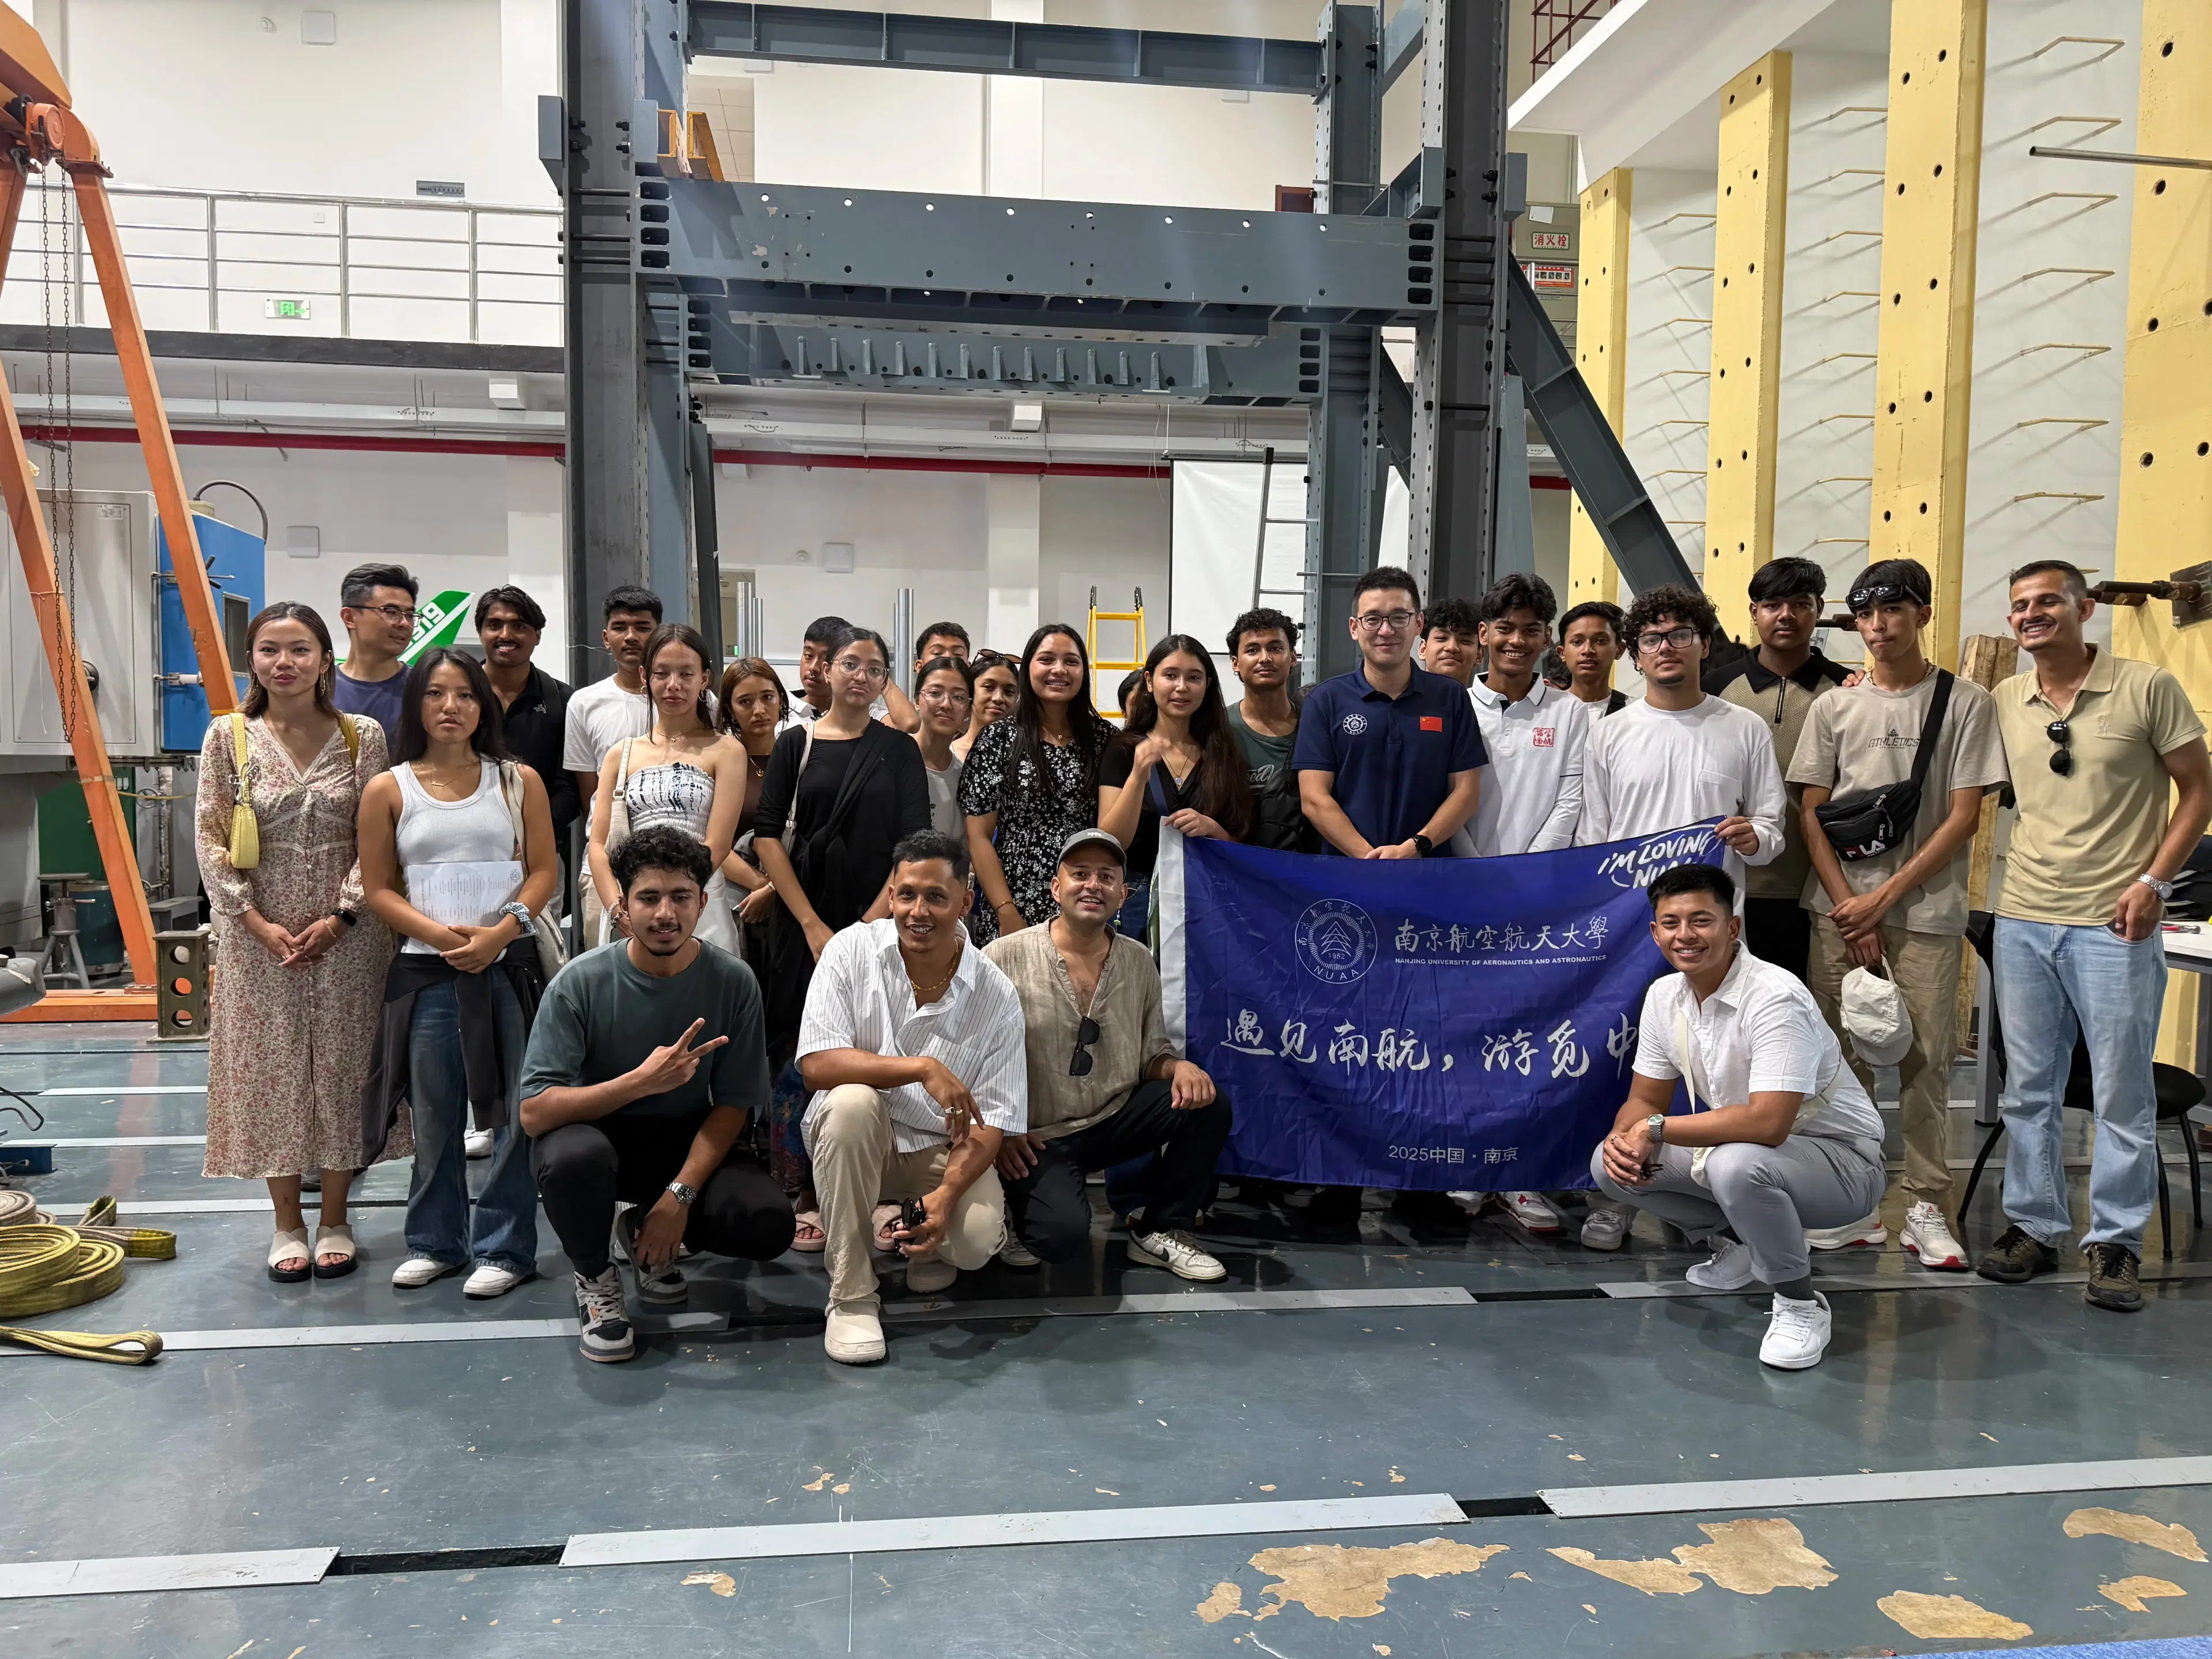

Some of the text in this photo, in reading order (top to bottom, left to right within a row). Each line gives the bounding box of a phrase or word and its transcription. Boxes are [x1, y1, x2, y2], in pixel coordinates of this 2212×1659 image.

[1535, 234, 1567, 247] 消火栓
[1597, 830, 1722, 875] I'M LOVING
[1551, 955, 1606, 964] ASTRONAUTICS
[1314, 965, 1359, 980] NUAA
